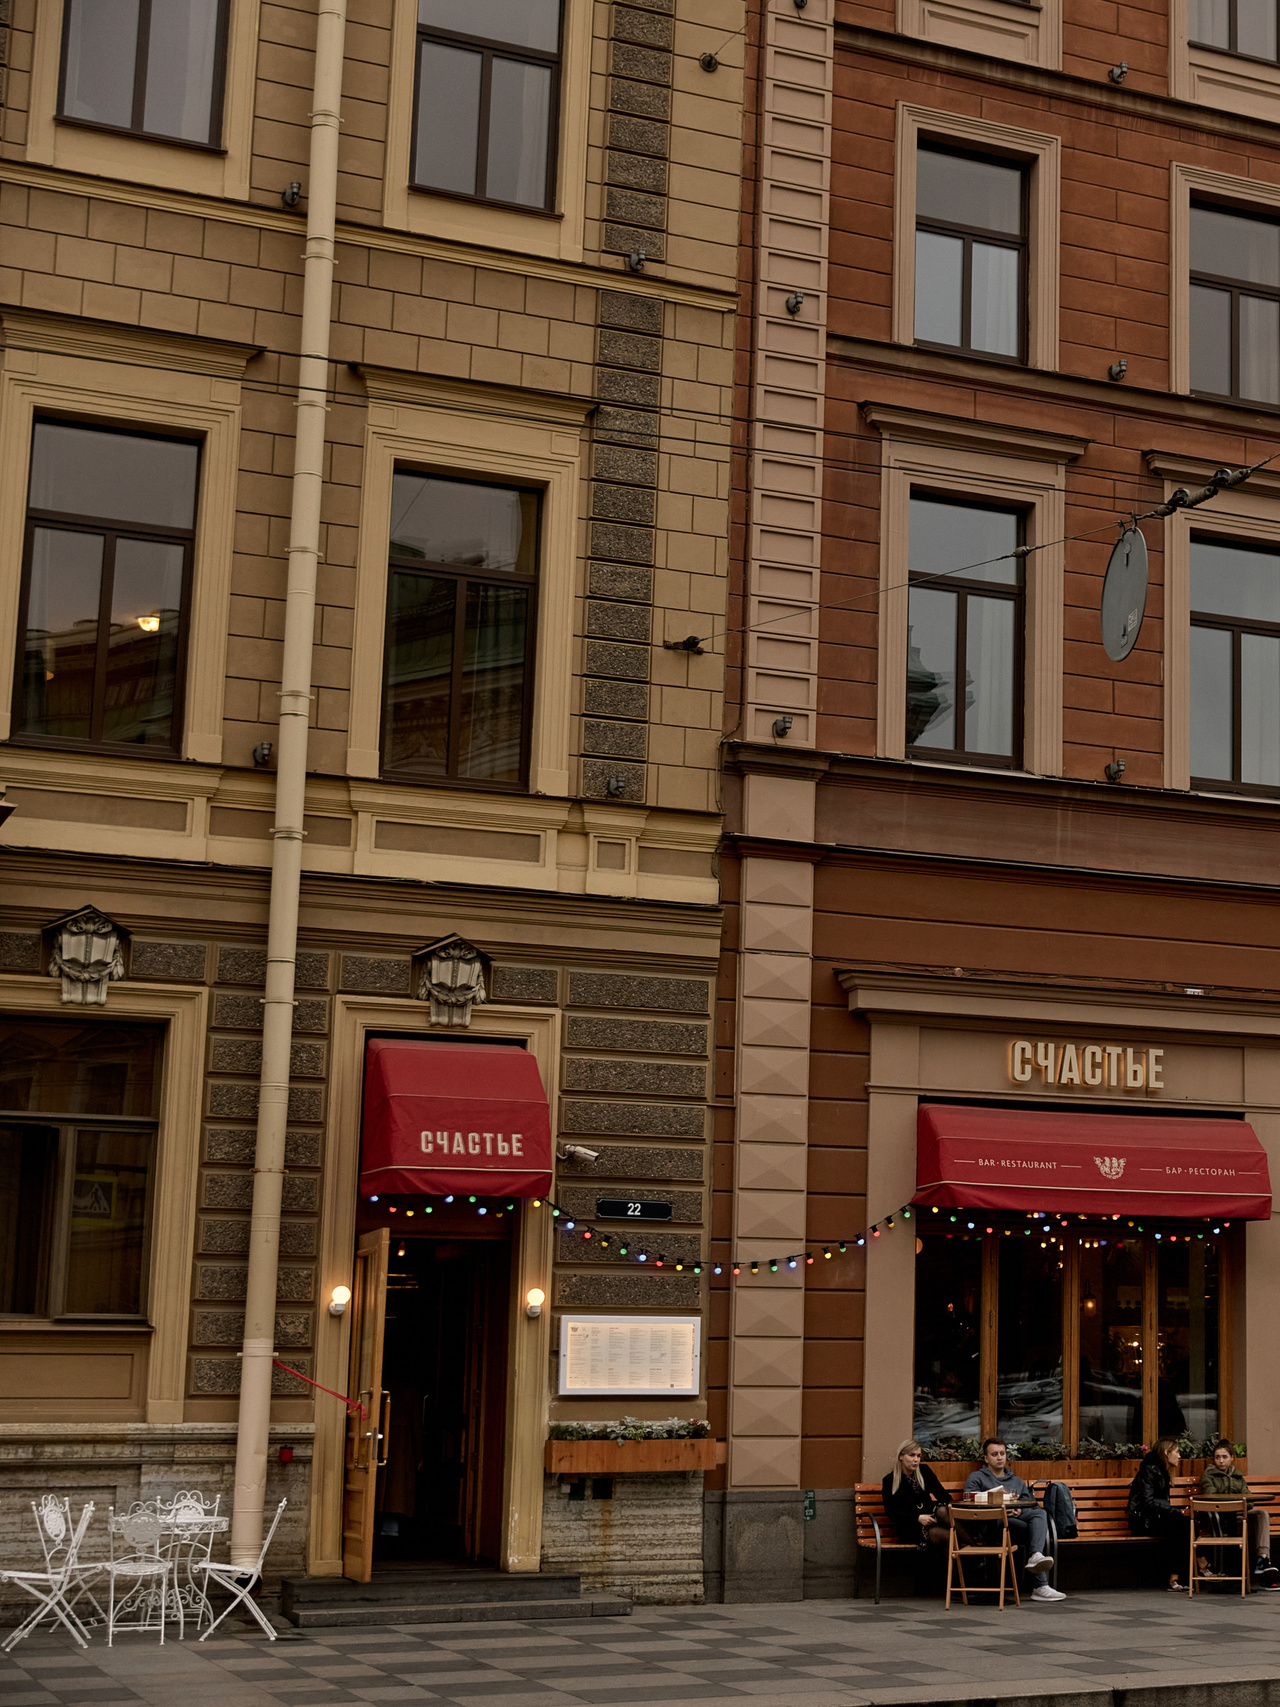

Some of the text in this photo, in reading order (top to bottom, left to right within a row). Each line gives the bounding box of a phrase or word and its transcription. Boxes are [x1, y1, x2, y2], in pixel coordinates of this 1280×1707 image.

[1012, 1040, 1165, 1089] СЧАСТЬЕ
[420, 1130, 524, 1157] СЧАСТЬЕ
[978, 1158, 1058, 1170] BAR RESTAURANT
[1165, 1166, 1236, 1176] БАР РЕСТОРАН
[627, 1203, 642, 1216] 22
